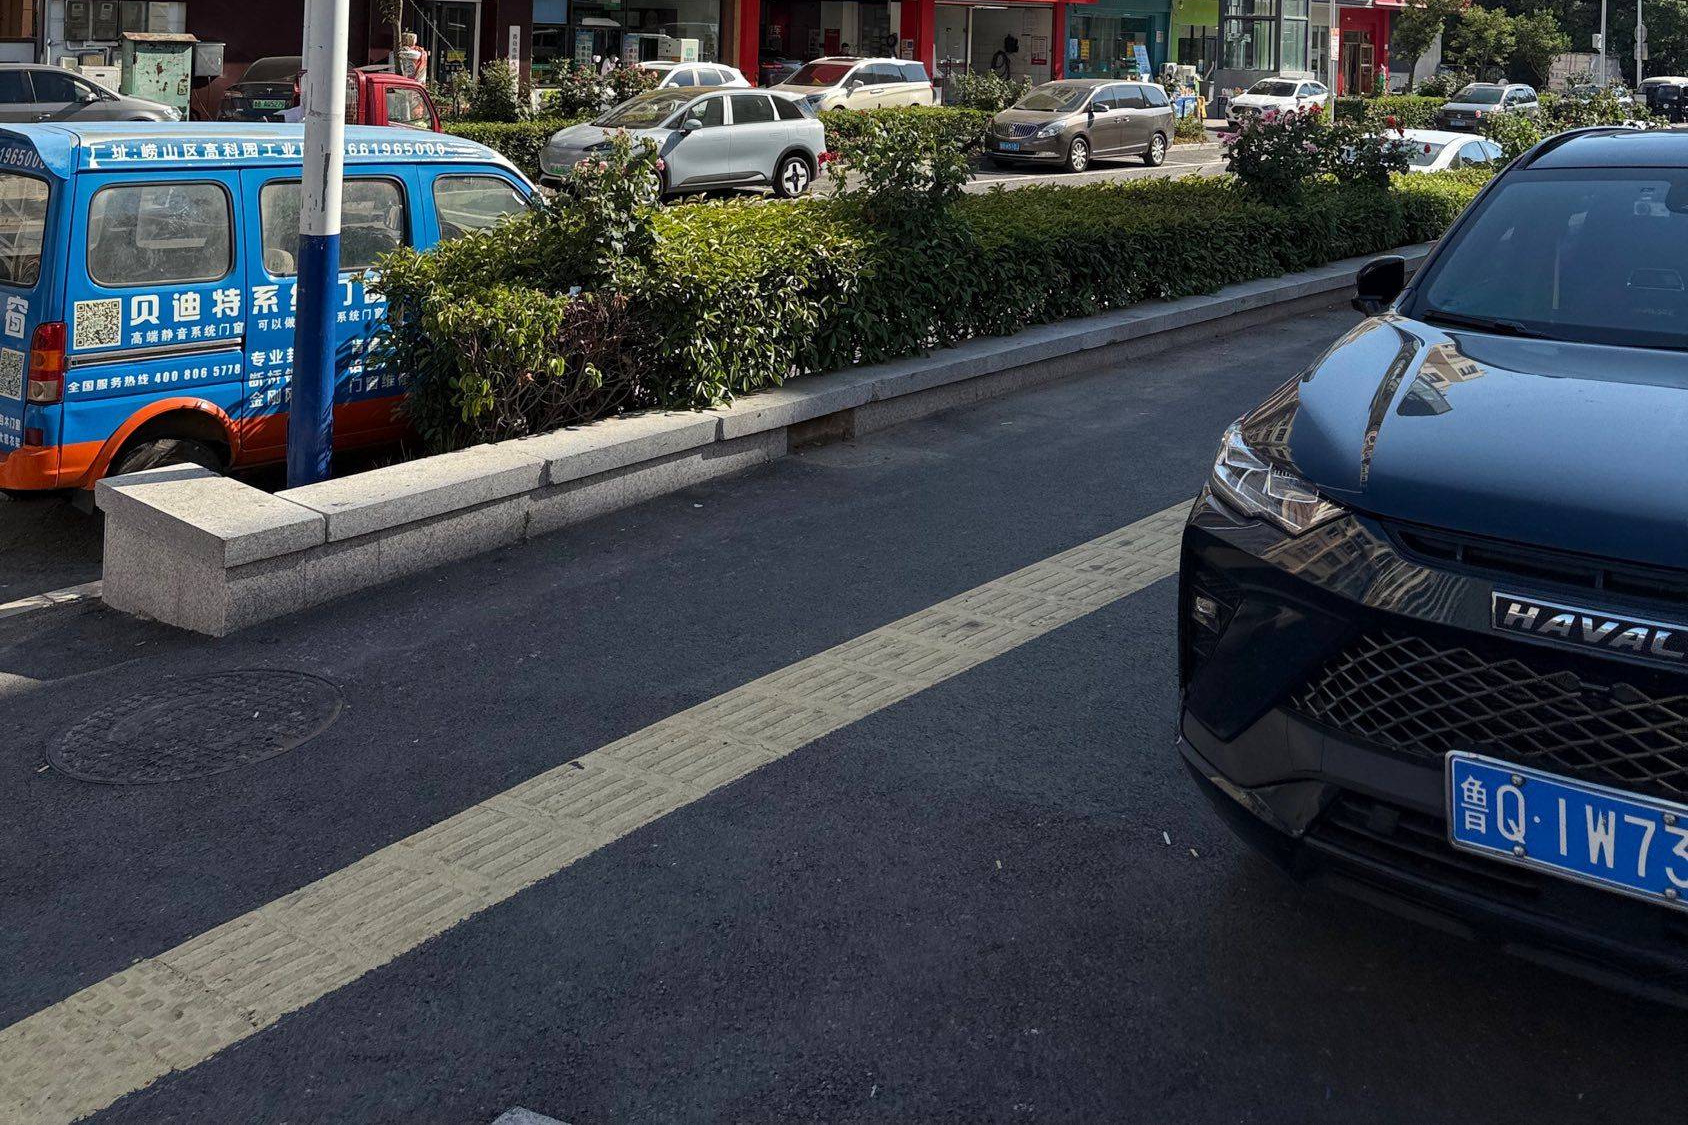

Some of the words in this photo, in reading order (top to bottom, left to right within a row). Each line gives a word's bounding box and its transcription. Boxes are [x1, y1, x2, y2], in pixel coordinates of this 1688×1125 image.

[90, 142, 304, 168] 厂址:崂山区高科园工业
[130, 321, 245, 345] 高端静音系统门窗
[67, 374, 150, 394] 全国服务热线
[154, 369, 179, 384] 400
[184, 367, 208, 381] 806
[213, 363, 242, 377] 5778
[1503, 603, 1685, 659] HAVAL
